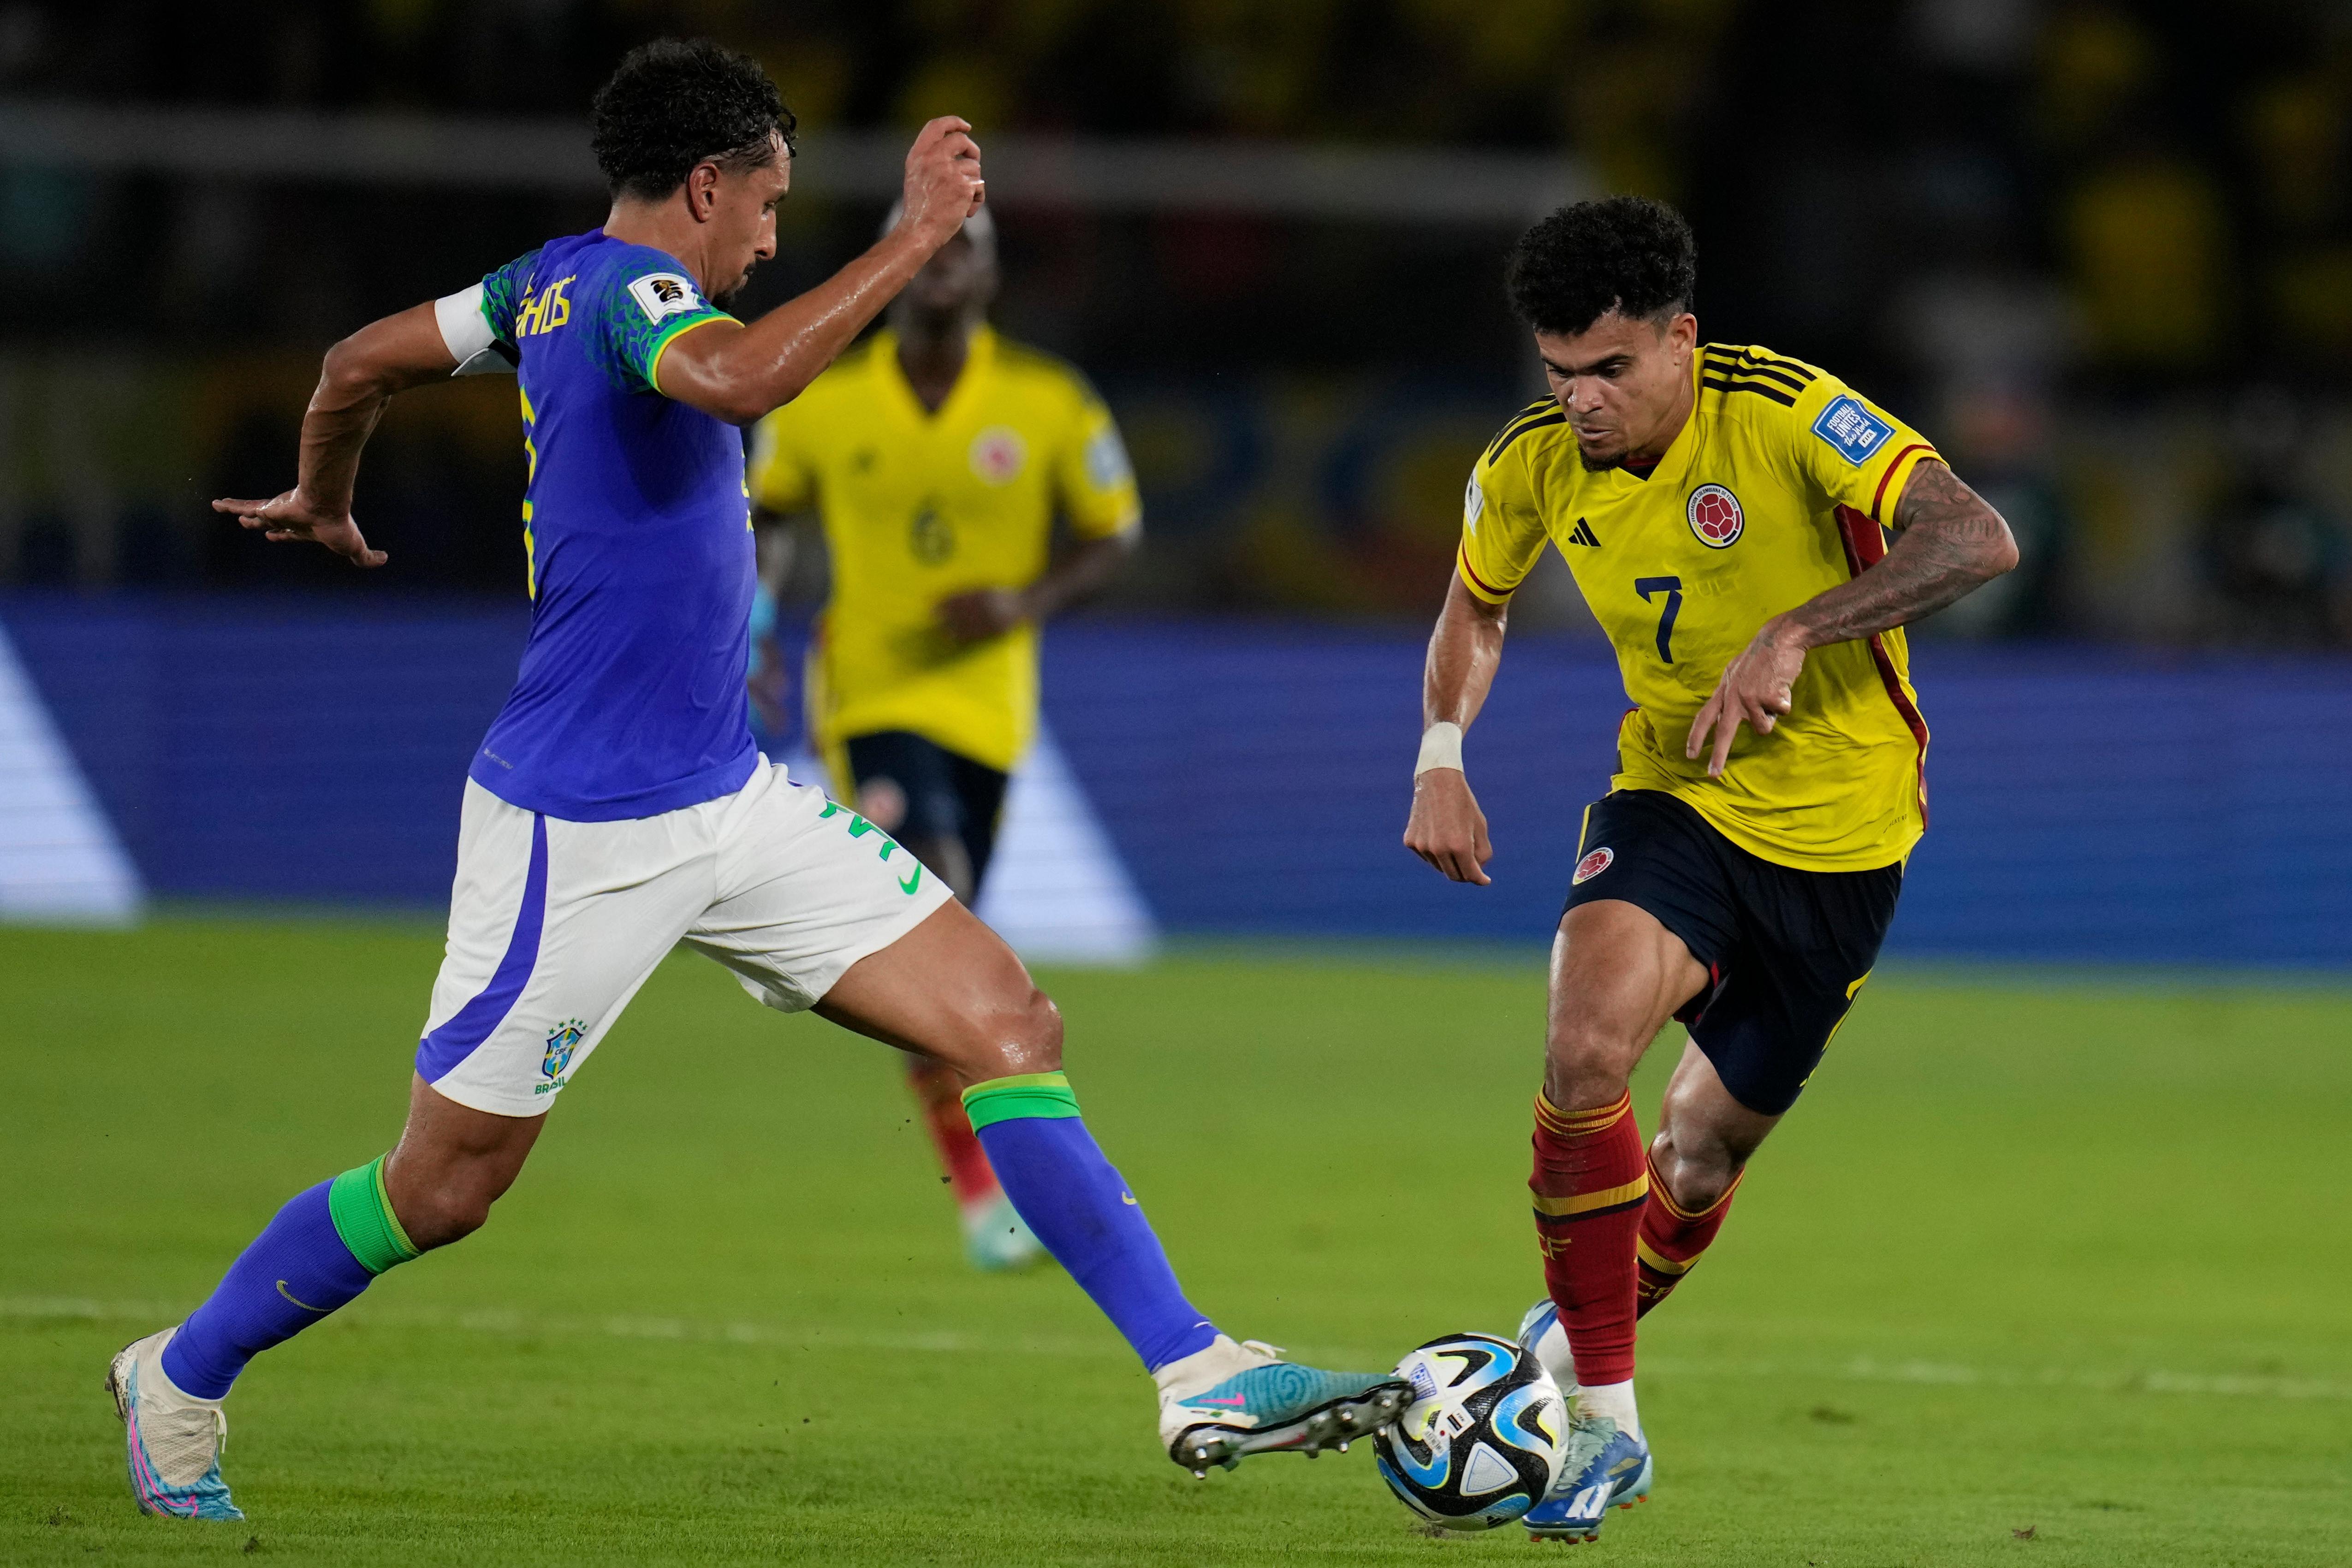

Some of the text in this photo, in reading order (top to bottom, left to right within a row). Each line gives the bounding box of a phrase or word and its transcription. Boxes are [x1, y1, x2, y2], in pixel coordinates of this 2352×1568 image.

[1827, 404, 1853, 430] FOOTBALL
[1835, 410, 1860, 438] UNITES
[1844, 417, 1871, 446] the World
[1862, 432, 1874, 445] FIFA
[1635, 576, 1682, 664] 7
[555, 1047, 567, 1056] CBF
[535, 1076, 567, 1094] BRASIL
